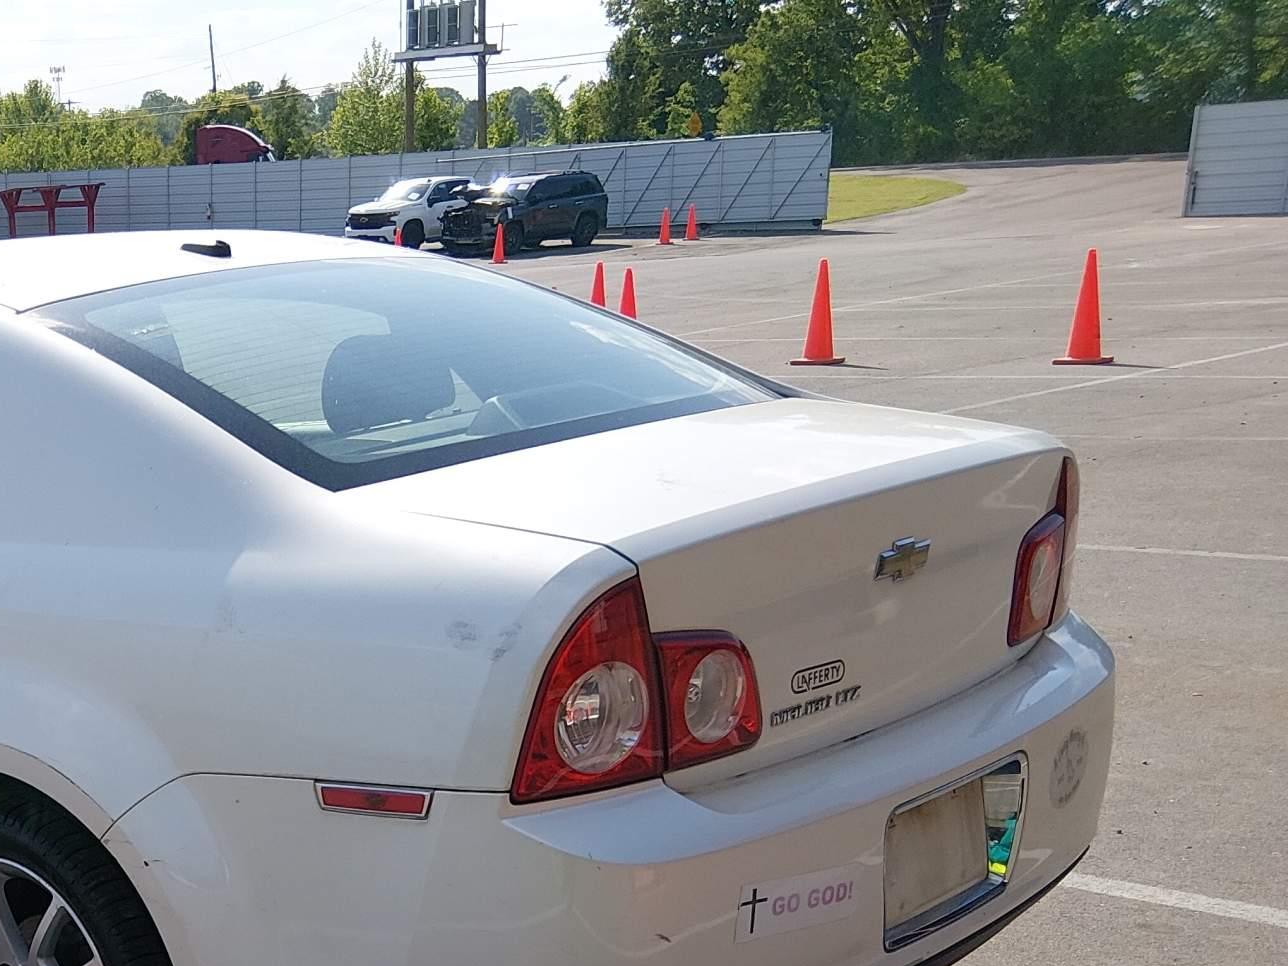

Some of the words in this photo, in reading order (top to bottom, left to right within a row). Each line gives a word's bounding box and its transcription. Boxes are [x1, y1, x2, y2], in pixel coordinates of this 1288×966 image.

[796, 664, 841, 690] LAFFERTY
[772, 893, 800, 916] GO
[807, 881, 853, 908] GOD!
